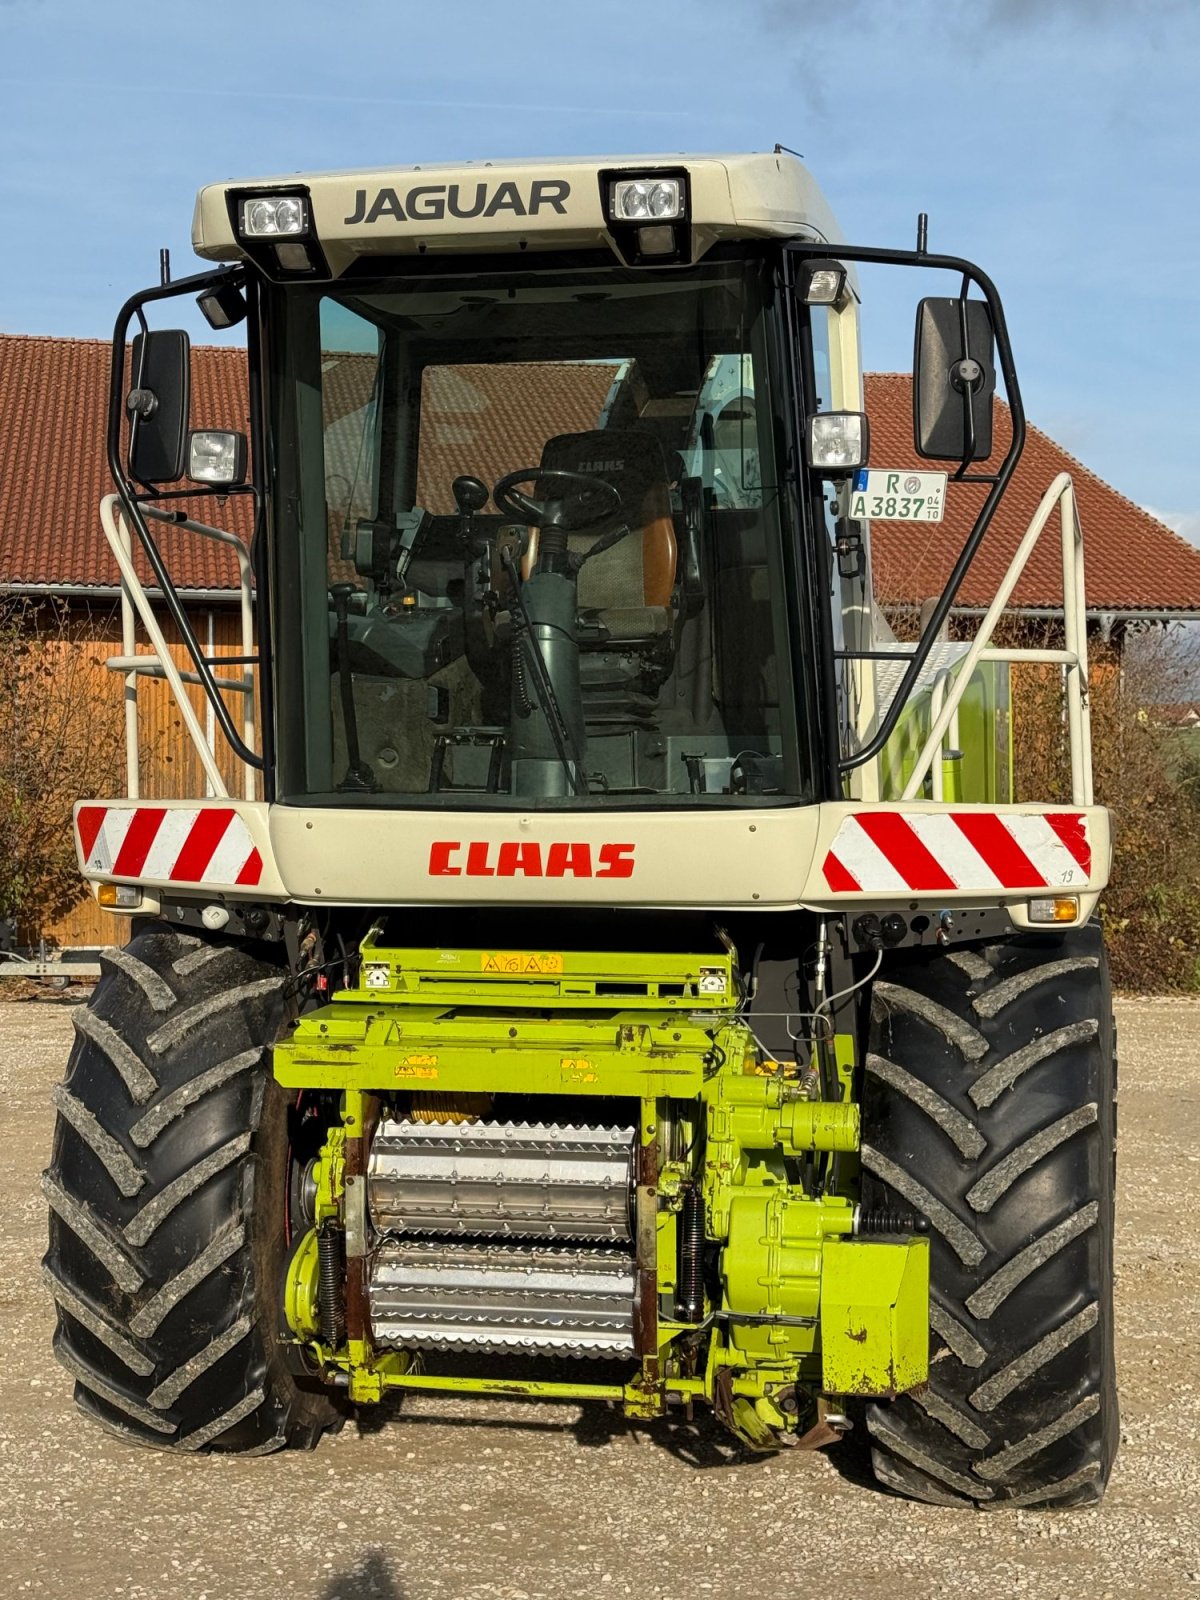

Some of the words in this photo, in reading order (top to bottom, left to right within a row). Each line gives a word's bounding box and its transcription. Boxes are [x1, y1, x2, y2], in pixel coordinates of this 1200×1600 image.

[344, 180, 571, 224] JAGUAR
[886, 474, 899, 494] R
[853, 496, 866, 516] A
[870, 497, 925, 518] 3837
[927, 496, 939, 505] 04
[927, 510, 939, 519] 10
[428, 842, 636, 878] CLAAS
[1061, 870, 1074, 883] 19
